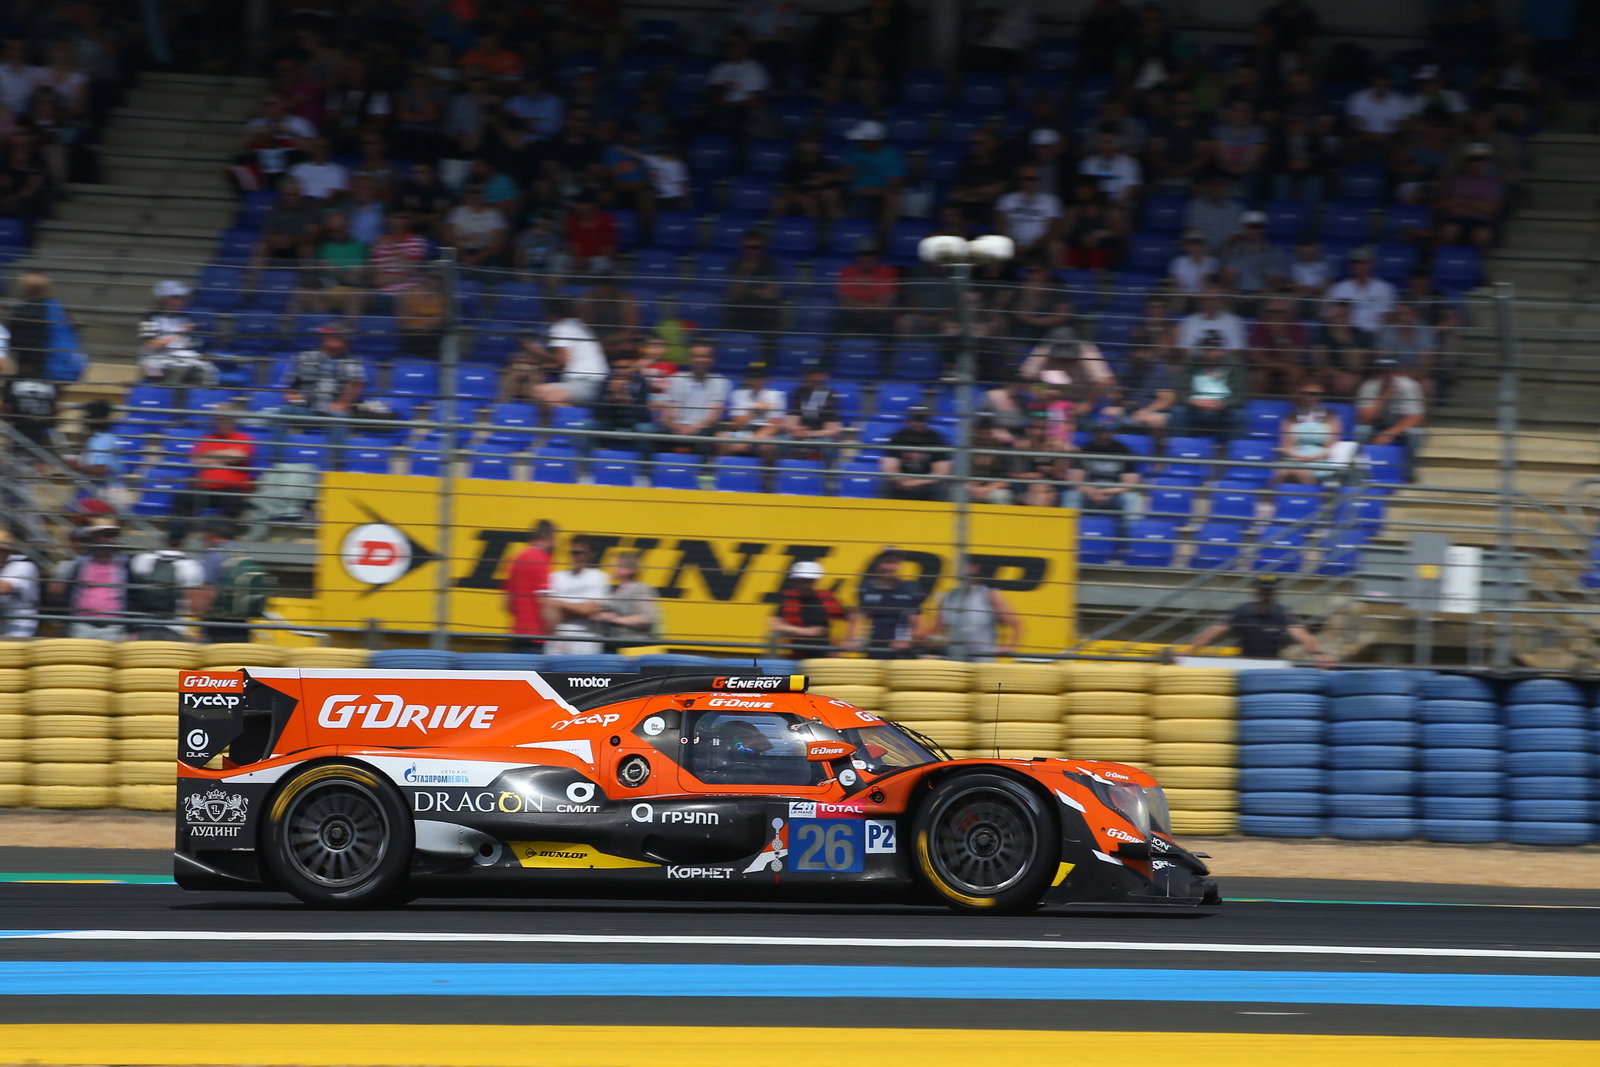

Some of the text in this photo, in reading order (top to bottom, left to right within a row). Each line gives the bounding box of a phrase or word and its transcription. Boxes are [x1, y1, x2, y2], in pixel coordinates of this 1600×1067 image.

[568, 676, 612, 688] motor
[414, 791, 544, 813] DRAGON
[818, 802, 863, 814] TOTAL
[556, 805, 600, 813] СМИТ
[190, 826, 242, 838] ЛУДИНГ
[868, 824, 894, 849] P2
[797, 823, 854, 871] 26
[539, 850, 588, 859] DUNLOP
